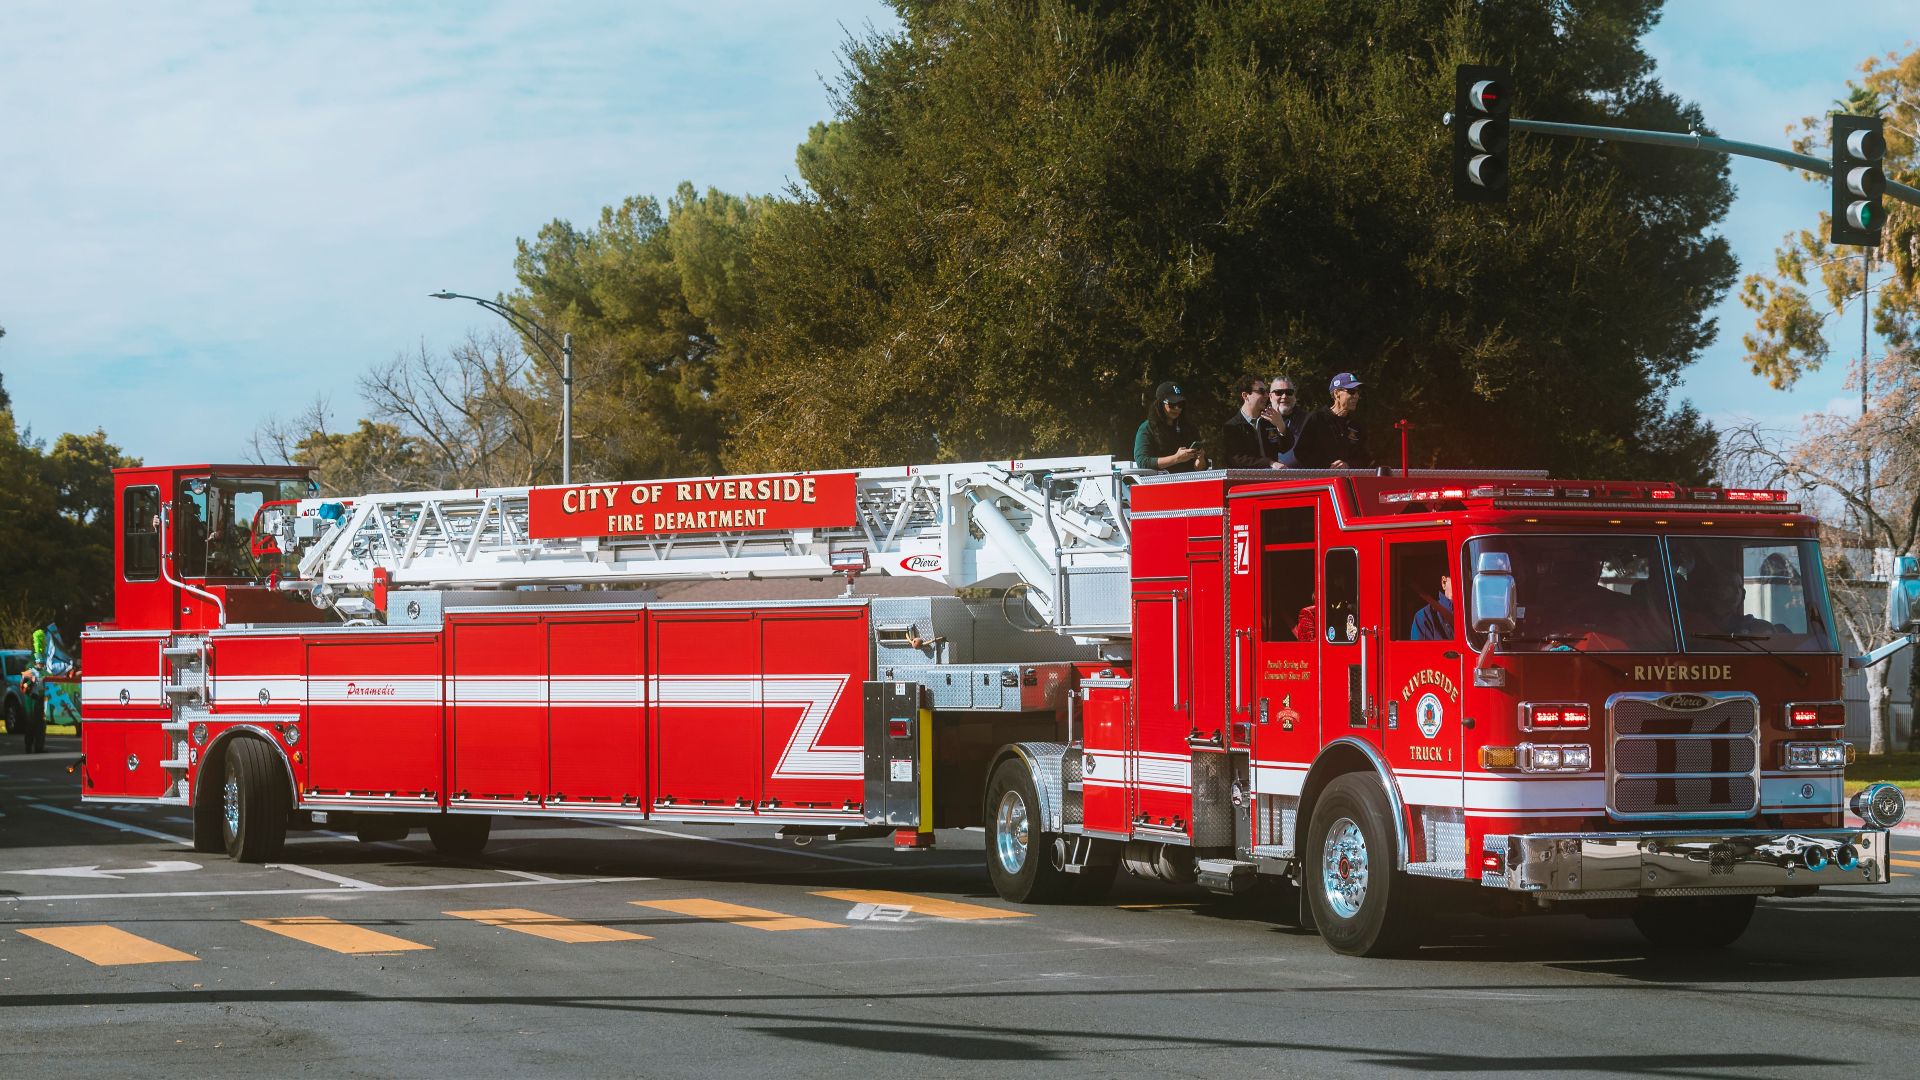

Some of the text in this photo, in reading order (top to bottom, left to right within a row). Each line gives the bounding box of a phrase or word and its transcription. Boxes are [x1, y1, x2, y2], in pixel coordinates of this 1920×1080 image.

[562, 478, 816, 514] CITY OF RIVERSIDE
[608, 508, 767, 532] FIRE DEPARTMENT
[911, 557, 939, 570] Pierce
[1634, 665, 1732, 681] RIVERSIDE
[346, 682, 395, 699] Paramedic
[1402, 669, 1459, 703] RIVERSIDE
[1670, 697, 1702, 709] Pierce
[1409, 746, 1452, 762] TRUCK 1
